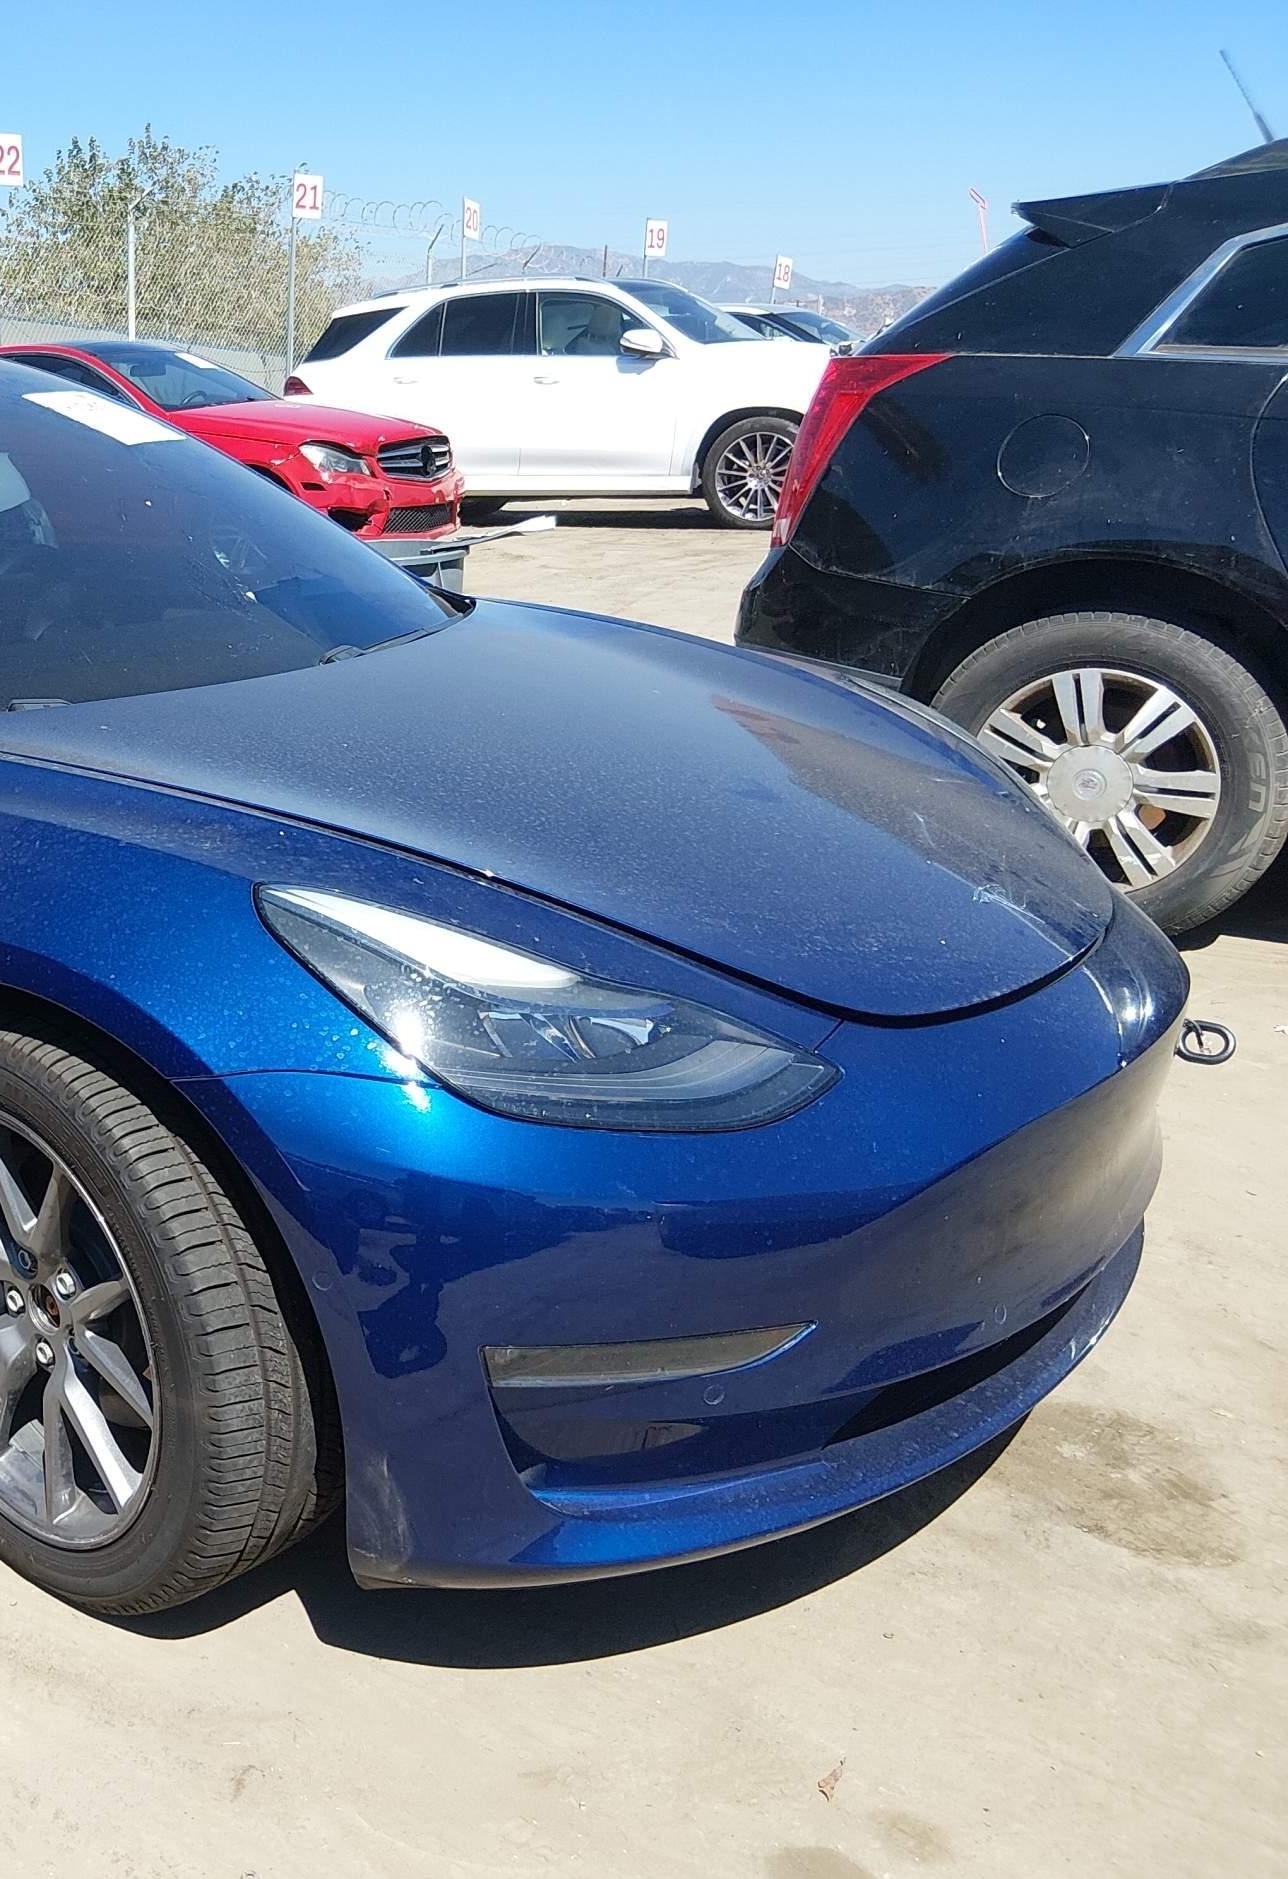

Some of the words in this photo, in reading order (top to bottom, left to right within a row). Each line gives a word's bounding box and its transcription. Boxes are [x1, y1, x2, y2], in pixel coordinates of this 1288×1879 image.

[295, 183, 320, 211] 21
[465, 206, 478, 232] 20
[647, 228, 665, 249] 19
[775, 263, 791, 282] 18
